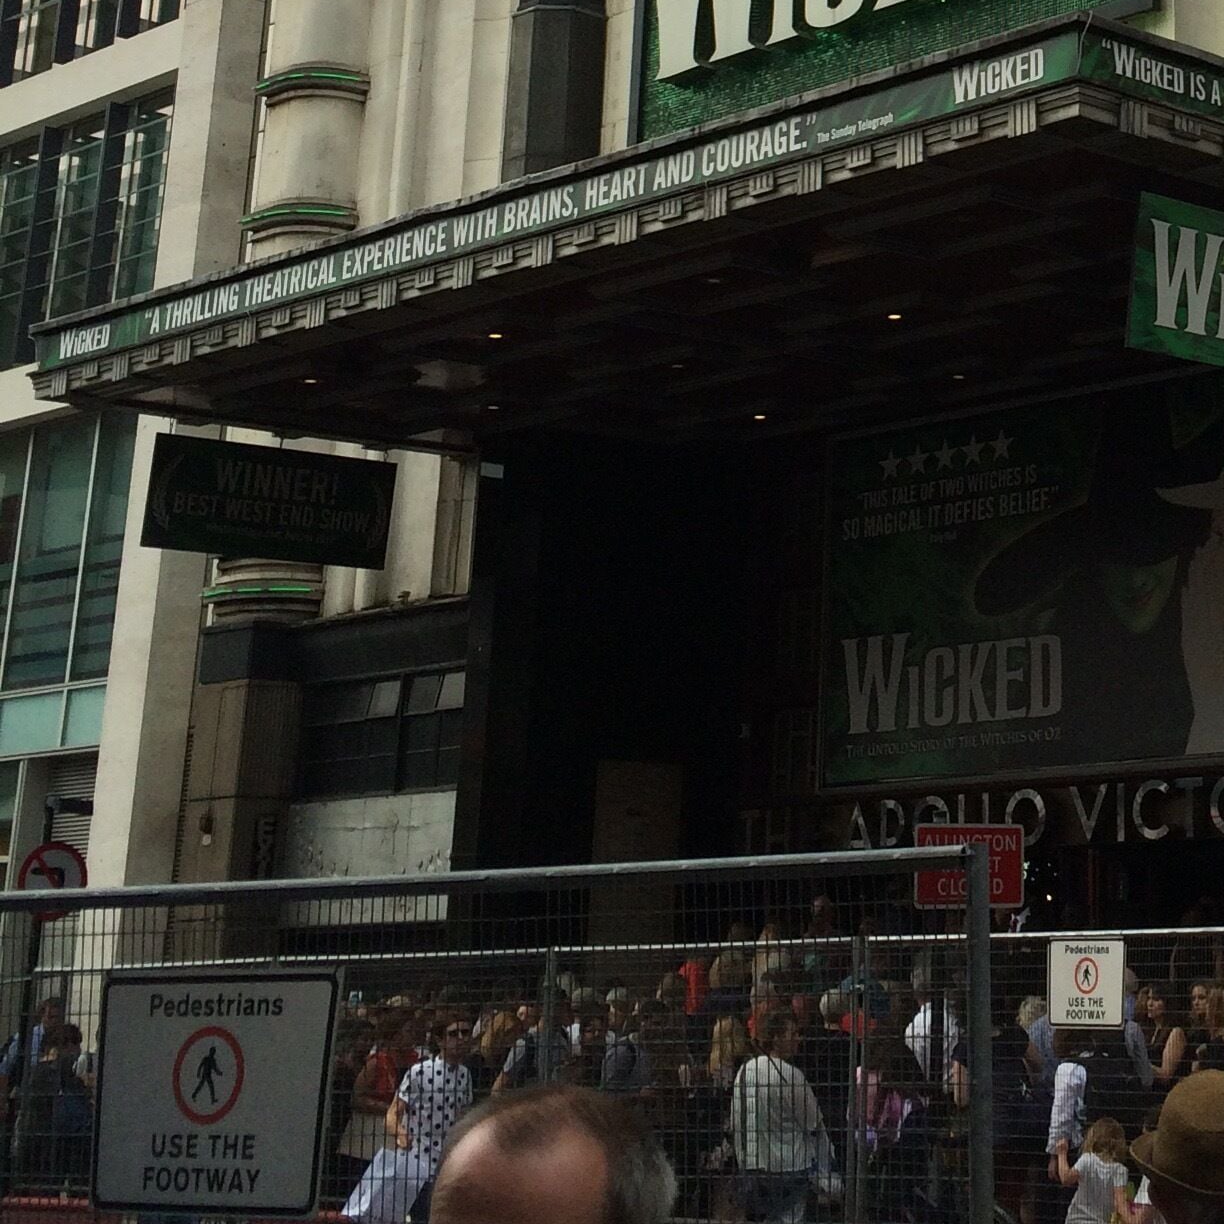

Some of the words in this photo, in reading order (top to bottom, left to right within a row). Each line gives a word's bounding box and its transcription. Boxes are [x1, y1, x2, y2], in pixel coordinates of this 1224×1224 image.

[1189, 71, 1207, 102] IS
[1210, 78, 1222, 107] A
[60, 323, 110, 360] WICKED
[164, 284, 240, 330] THRILLING
[244, 260, 337, 306] THEATRICAL
[341, 225, 447, 279] EXPERIENCE
[452, 205, 500, 249] WITH
[502, 188, 579, 236] BRAINS,
[584, 164, 647, 211] HEART
[652, 150, 696, 192] AND
[817, 132, 830, 144] The
[830, 121, 856, 141] Sunday
[856, 112, 894, 134] Telegraph
[951, 48, 1045, 105] WICKED
[217, 459, 342, 506] WINNER!
[890, 485, 917, 506] TALE
[919, 483, 936, 503] OF
[937, 476, 964, 499] TWO
[966, 467, 1021, 494] WITCHES
[1023, 463, 1038, 485] IS
[172, 491, 220, 516] BEST
[221, 497, 274, 524] WEST
[280, 502, 318, 528] END
[320, 507, 370, 535] SHOW
[842, 518, 860, 541] SO
[862, 508, 925, 538] MAGICAL
[927, 503, 942, 528] IT
[942, 495, 995, 524] DEFIES
[841, 632, 1063, 735] WICKED
[937, 877, 1004, 896] CLOD
[1064, 944, 1110, 954] Pedestrians
[149, 992, 284, 1018] Pedestrians
[1066, 1009, 1106, 1020] FOOTWAY
[1068, 997, 1085, 1008] USE
[1088, 997, 1104, 1008] THE
[151, 1133, 199, 1160] USE
[207, 1134, 257, 1161] THE
[142, 1166, 261, 1195] FOOTWAY
